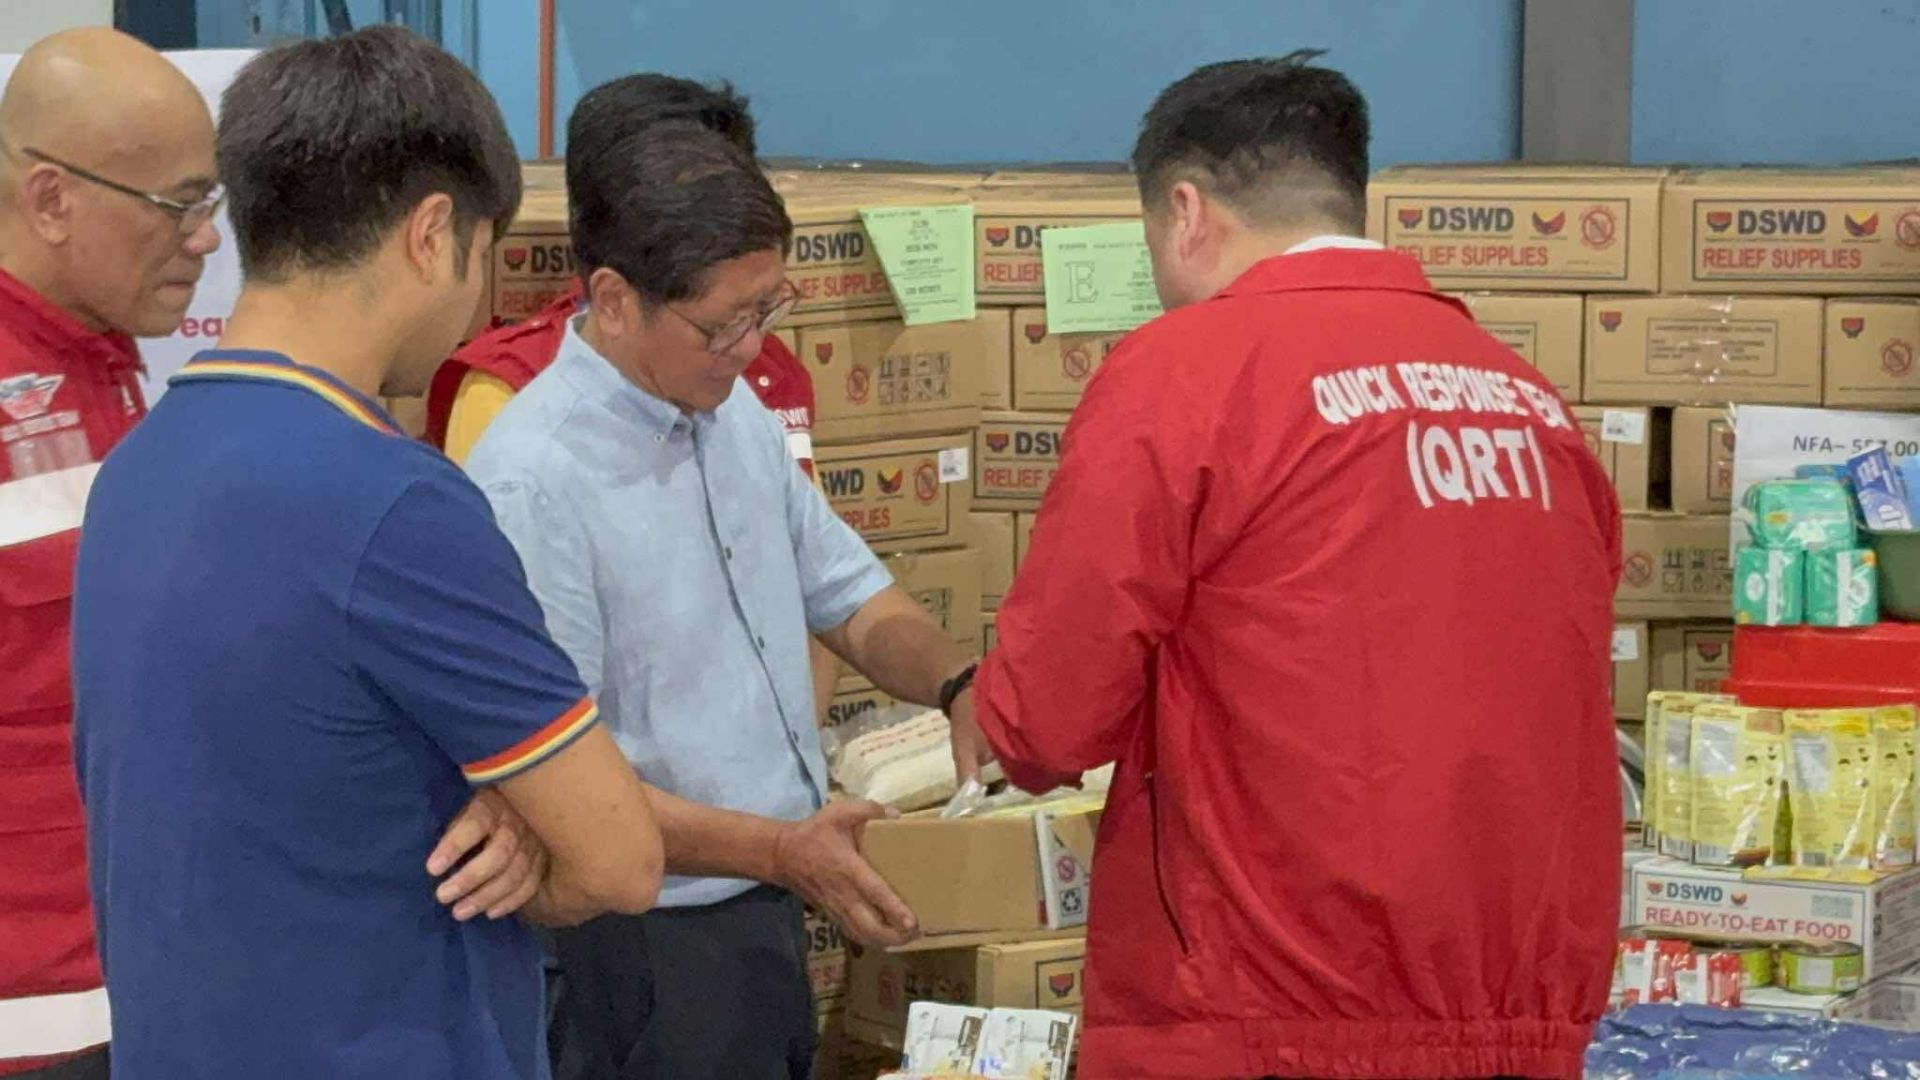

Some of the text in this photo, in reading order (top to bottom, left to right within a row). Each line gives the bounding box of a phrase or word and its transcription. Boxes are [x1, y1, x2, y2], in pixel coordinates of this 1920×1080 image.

[1428, 207, 1514, 231] DSWD
[1737, 209, 1826, 234] DSWD
[531, 245, 574, 272] DS
[795, 232, 864, 261] DSWD
[1461, 246, 1548, 266] SUPPLIES
[1704, 248, 1862, 268] RELIEF SUPPLIES
[823, 271, 888, 298] SUPPLIE
[1065, 261, 1098, 303] E
[1312, 365, 1407, 425] QUICK
[1396, 361, 1529, 416] RESPONSE
[1015, 431, 1060, 454] DS
[984, 468, 1043, 487] RELIEF
[1407, 420, 1551, 511] (QRT)
[819, 468, 864, 496] SWD
[1667, 883, 1723, 902] DSWD
[1645, 906, 1788, 933] READY-TO-EAT
[1794, 920, 1851, 940] FOOD
